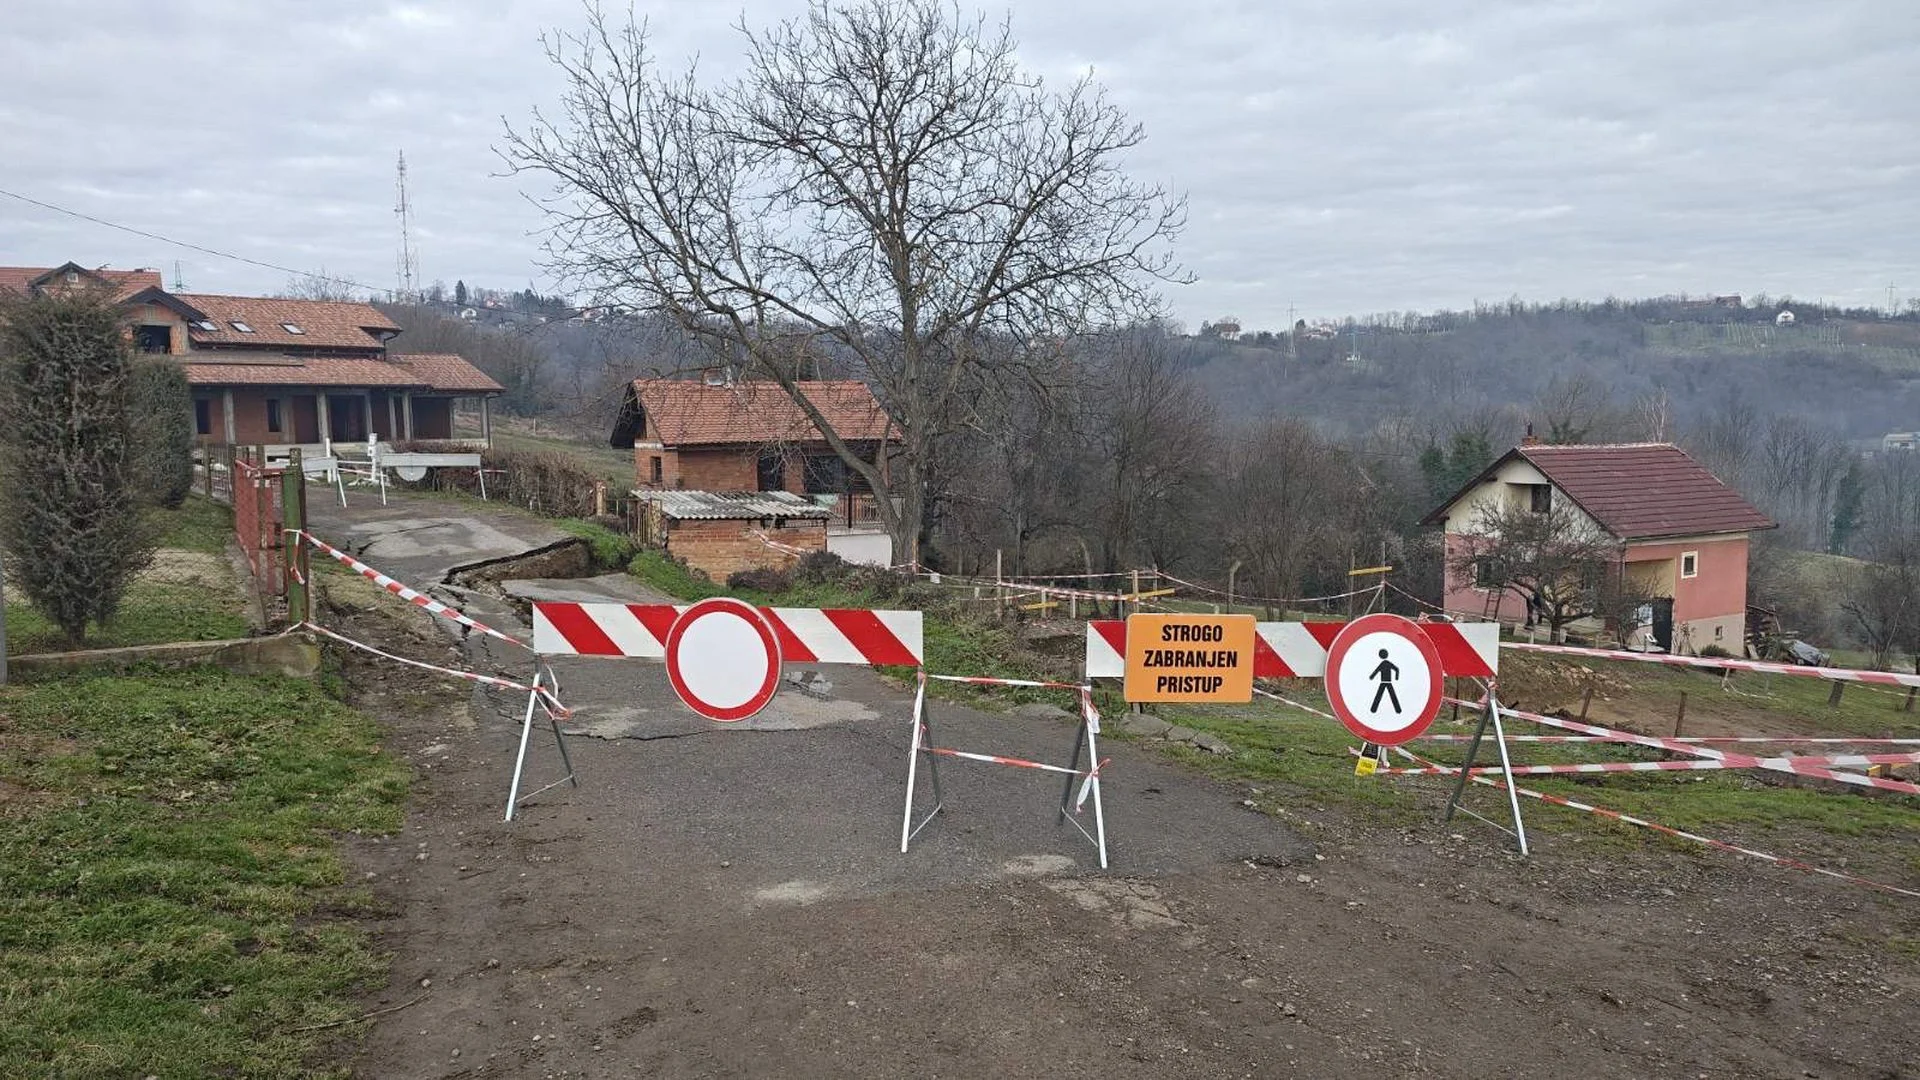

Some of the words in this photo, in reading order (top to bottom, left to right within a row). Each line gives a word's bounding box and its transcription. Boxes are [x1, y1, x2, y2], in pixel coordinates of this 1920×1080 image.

[1162, 624, 1223, 642] STROGO
[1143, 650, 1238, 668] ZABRANJEN
[1157, 676, 1223, 693] PRISTUP
